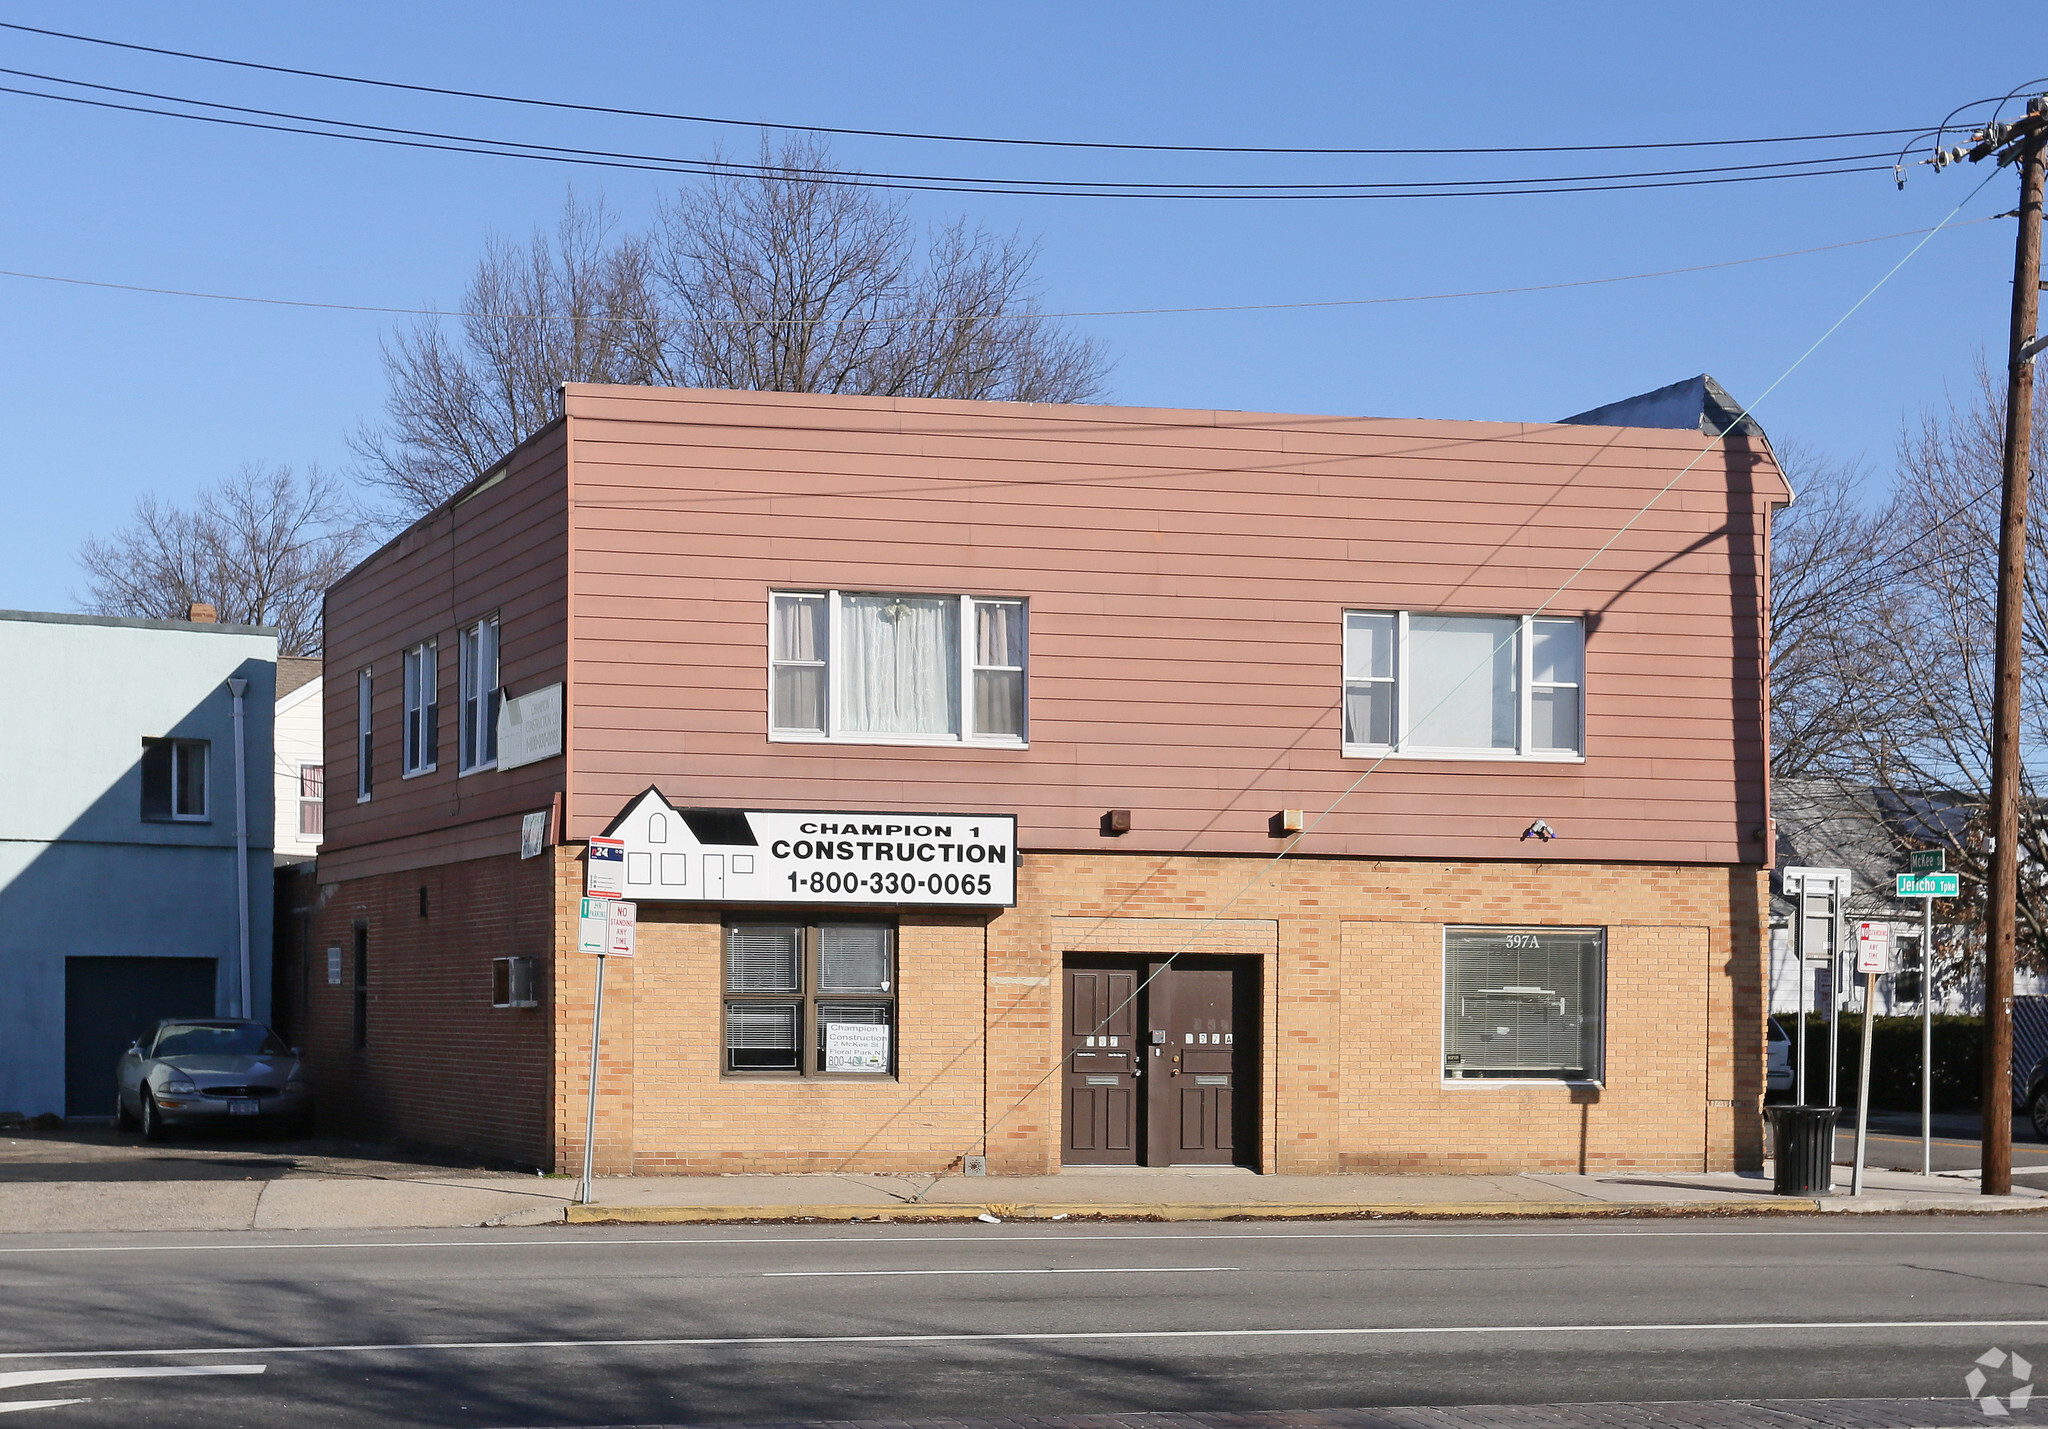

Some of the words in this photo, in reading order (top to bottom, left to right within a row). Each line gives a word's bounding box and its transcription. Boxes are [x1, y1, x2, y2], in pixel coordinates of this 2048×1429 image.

[800, 822, 952, 838] CHAMPION
[969, 826, 980, 838] 1
[771, 840, 1006, 864] CONSTRUCTION
[1912, 854, 1934, 867] McKee
[787, 870, 992, 896] 1-800-330-0065
[1900, 877, 1936, 892] Jericho
[1940, 880, 1956, 894] Tpke
[617, 906, 628, 917] NO
[610, 918, 634, 928] STANDING
[616, 928, 628, 936] ANY
[615, 937, 627, 945] TIME
[1505, 934, 1540, 948] 397A
[830, 1024, 878, 1033] Champion
[829, 1033, 887, 1041] Construction
